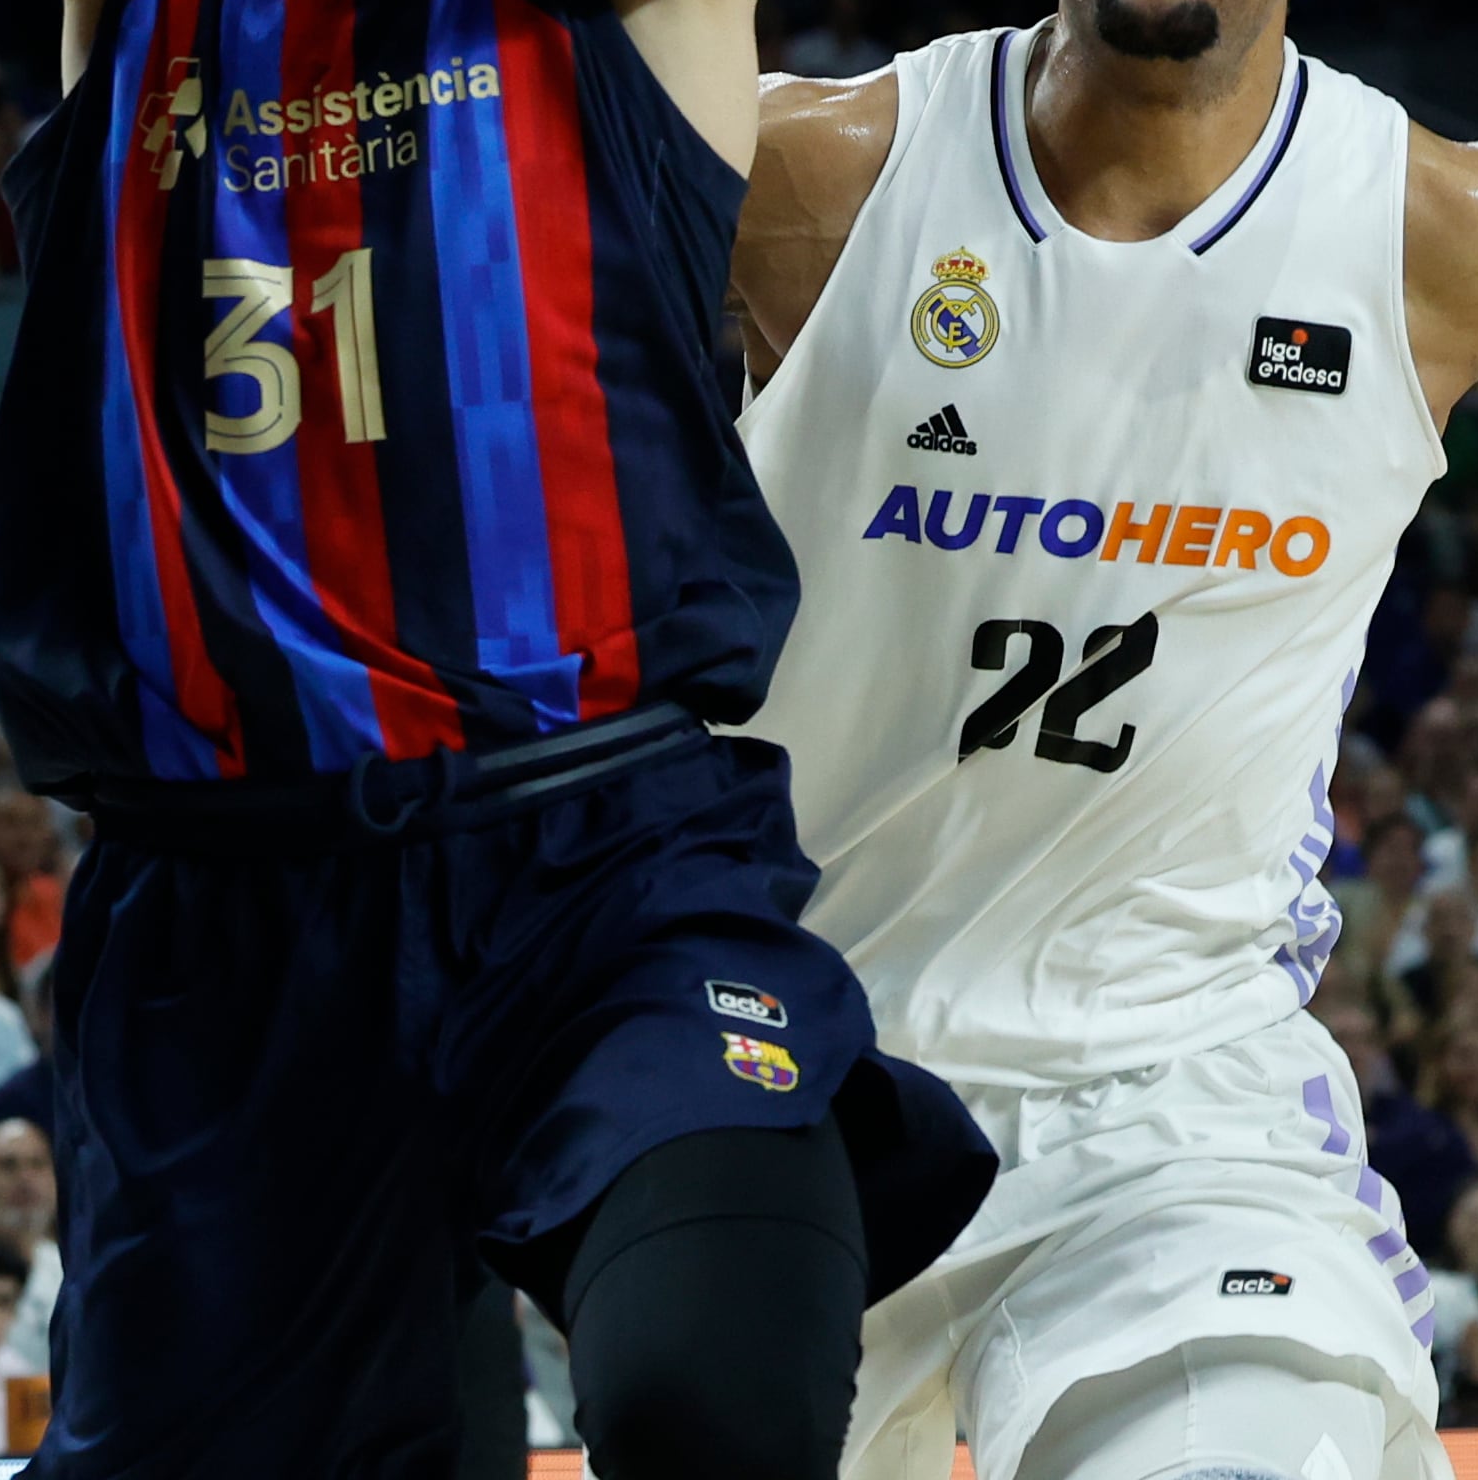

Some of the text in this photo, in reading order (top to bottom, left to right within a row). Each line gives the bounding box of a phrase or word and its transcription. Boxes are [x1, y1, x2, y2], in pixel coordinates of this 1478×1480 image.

[223, 56, 501, 135] Assistència
[223, 123, 418, 192] Sanitària
[201, 247, 388, 455] 31
[1261, 336, 1301, 362] liga
[1258, 361, 1342, 388] endesa
[906, 430, 977, 455] adidas
[861, 484, 1331, 578] AUTOHERO
[957, 610, 1160, 774] 22
[717, 991, 770, 1018] acb
[1225, 1276, 1276, 1294] acb
